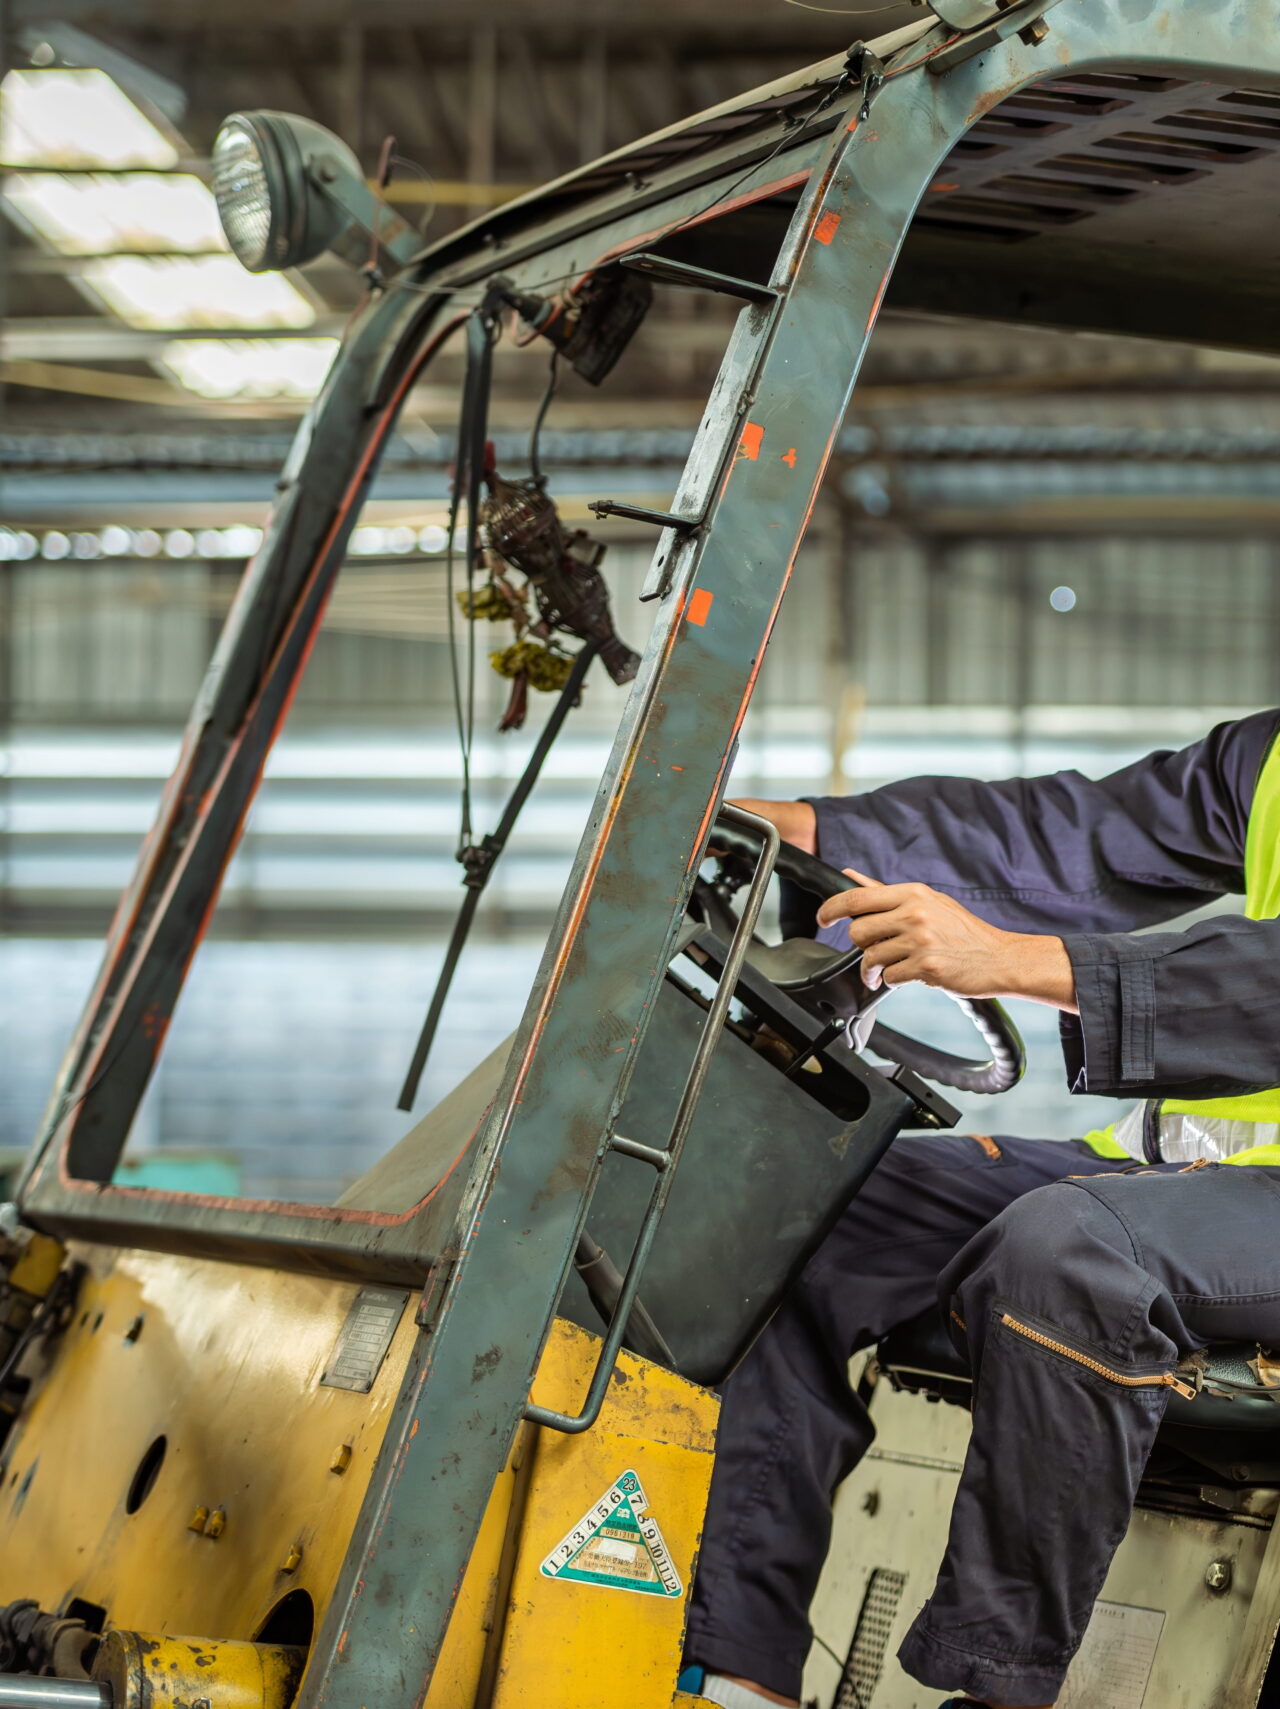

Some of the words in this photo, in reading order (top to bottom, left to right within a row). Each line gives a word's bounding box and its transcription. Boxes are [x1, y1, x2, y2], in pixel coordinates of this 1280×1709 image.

[622, 1477, 636, 1491] 23
[631, 1494, 643, 1505] 7
[549, 1560, 560, 1571] 1
[561, 1545, 573, 1558] 2
[573, 1531, 585, 1544] 3
[586, 1519, 597, 1531] 4
[597, 1505, 609, 1518] 5
[610, 1491, 621, 1504] 6
[643, 1528, 656, 1539] 9
[650, 1544, 663, 1558] 10
[656, 1559, 670, 1575] 11
[663, 1575, 677, 1592] 12
